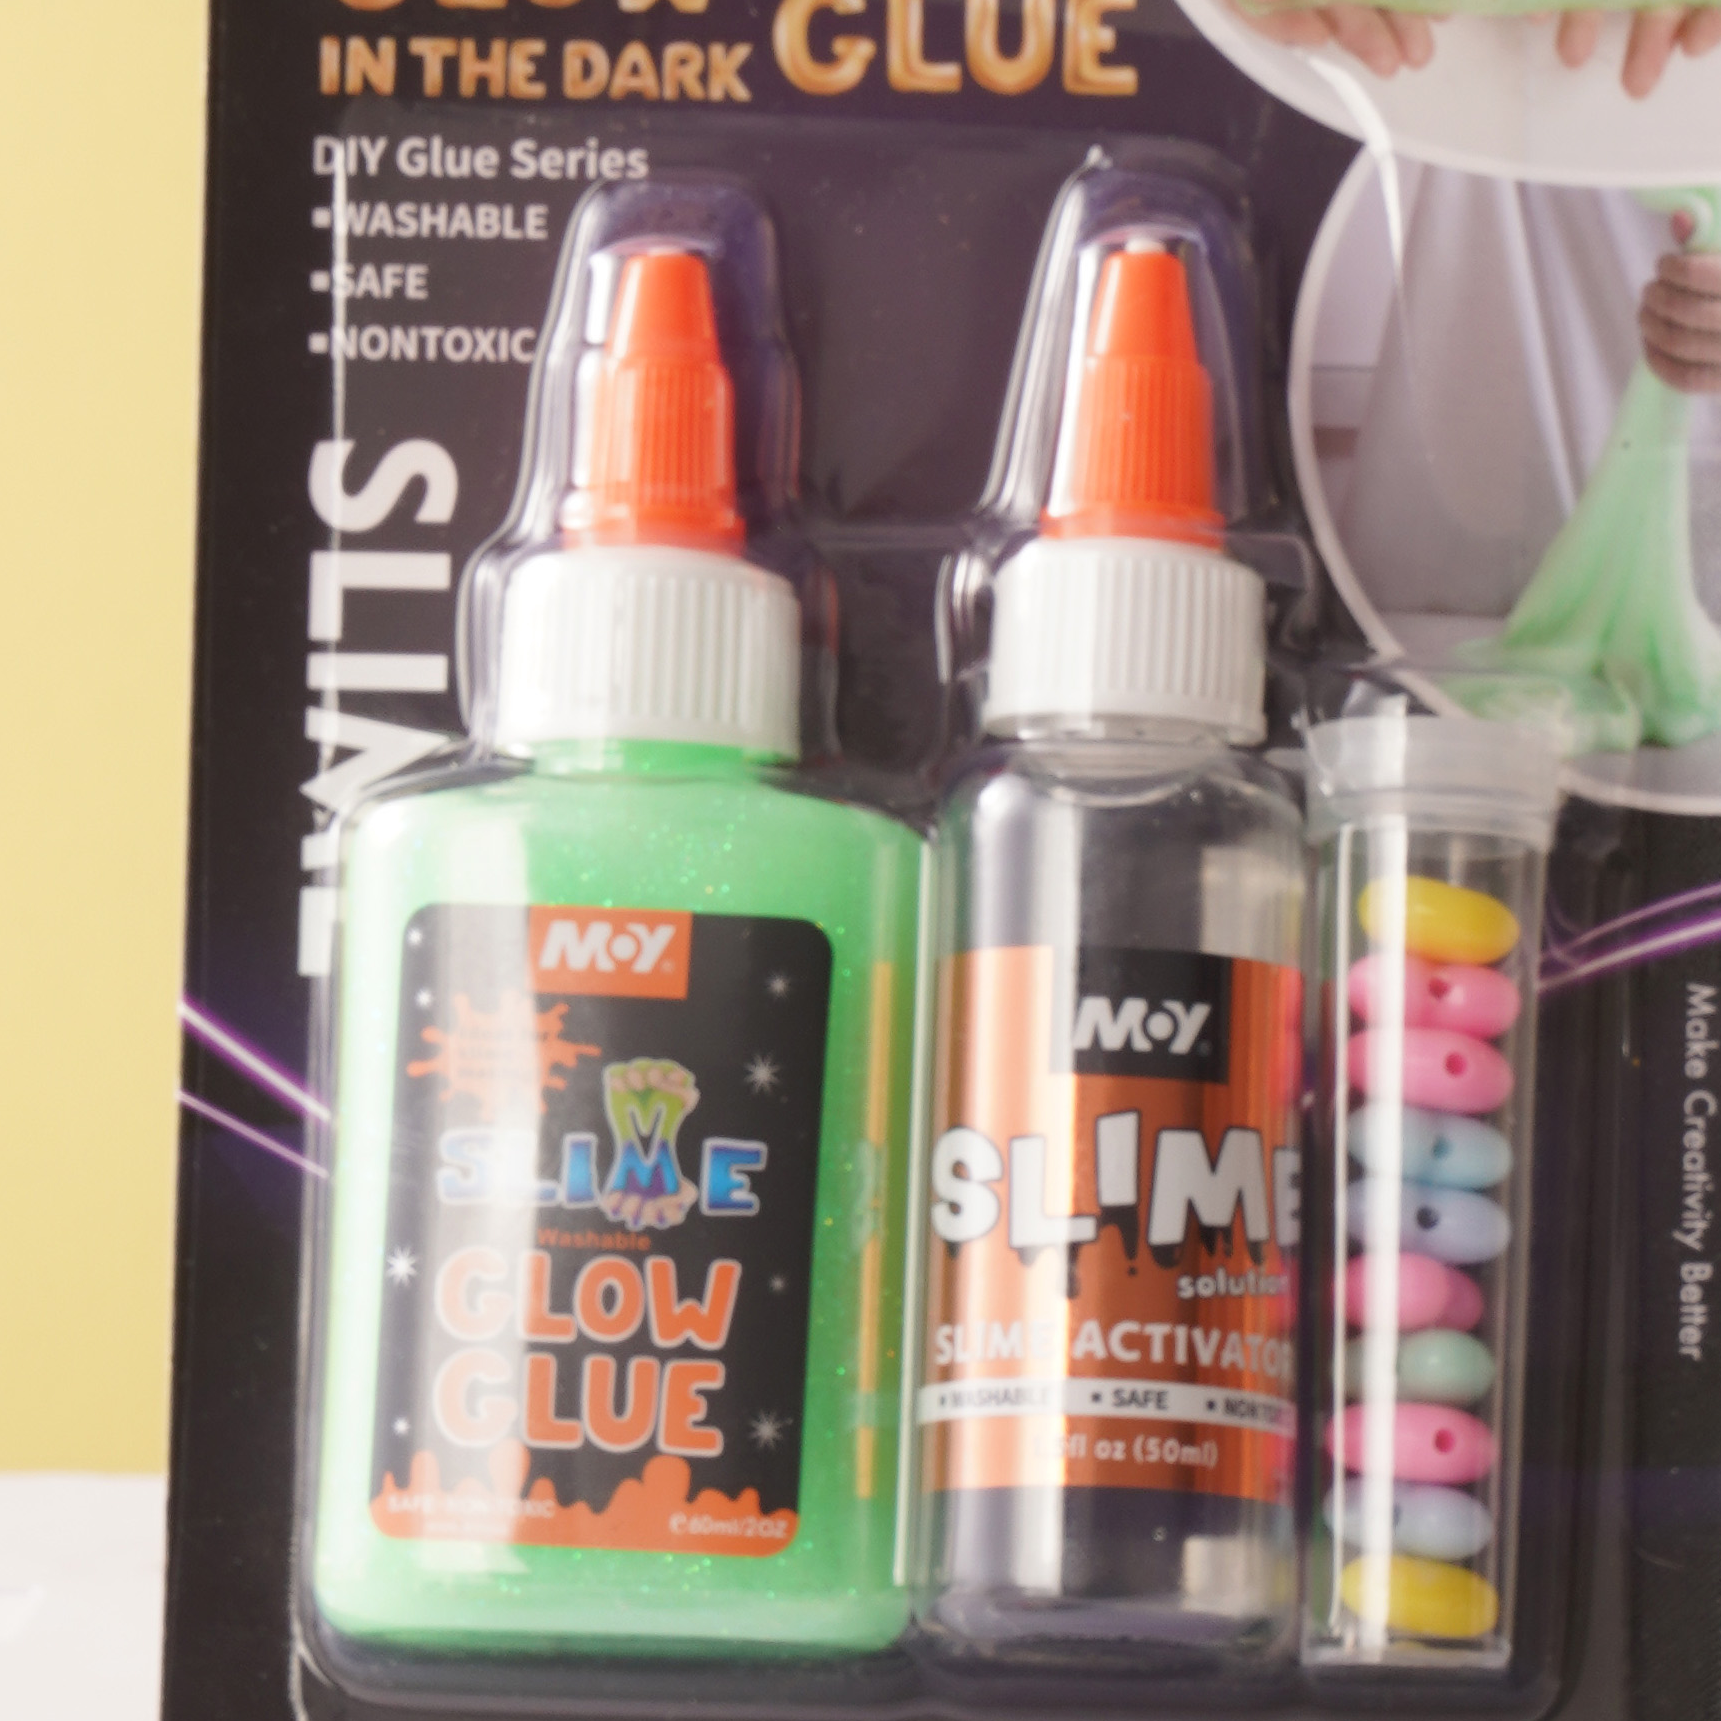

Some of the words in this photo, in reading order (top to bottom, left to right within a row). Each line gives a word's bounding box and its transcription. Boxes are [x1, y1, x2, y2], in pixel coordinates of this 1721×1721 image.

[320, 36, 397, 96] IN
[409, 36, 546, 100] THE
[561, 40, 753, 103] DARK
[312, 135, 387, 176] DIY
[396, 135, 499, 178] Glue
[510, 137, 650, 179] Series
[1684, 982, 1719, 1079] Make
[1672, 1089, 1718, 1251] Creativity
[434, 1244, 743, 1350] GLOW
[1678, 1261, 1714, 1361] Better
[432, 1347, 725, 1458] GLUE
[1112, 1388, 1169, 1411] SAFE
[1098, 1438, 1126, 1461] oz
[1132, 1435, 1219, 1469] (50ml)
